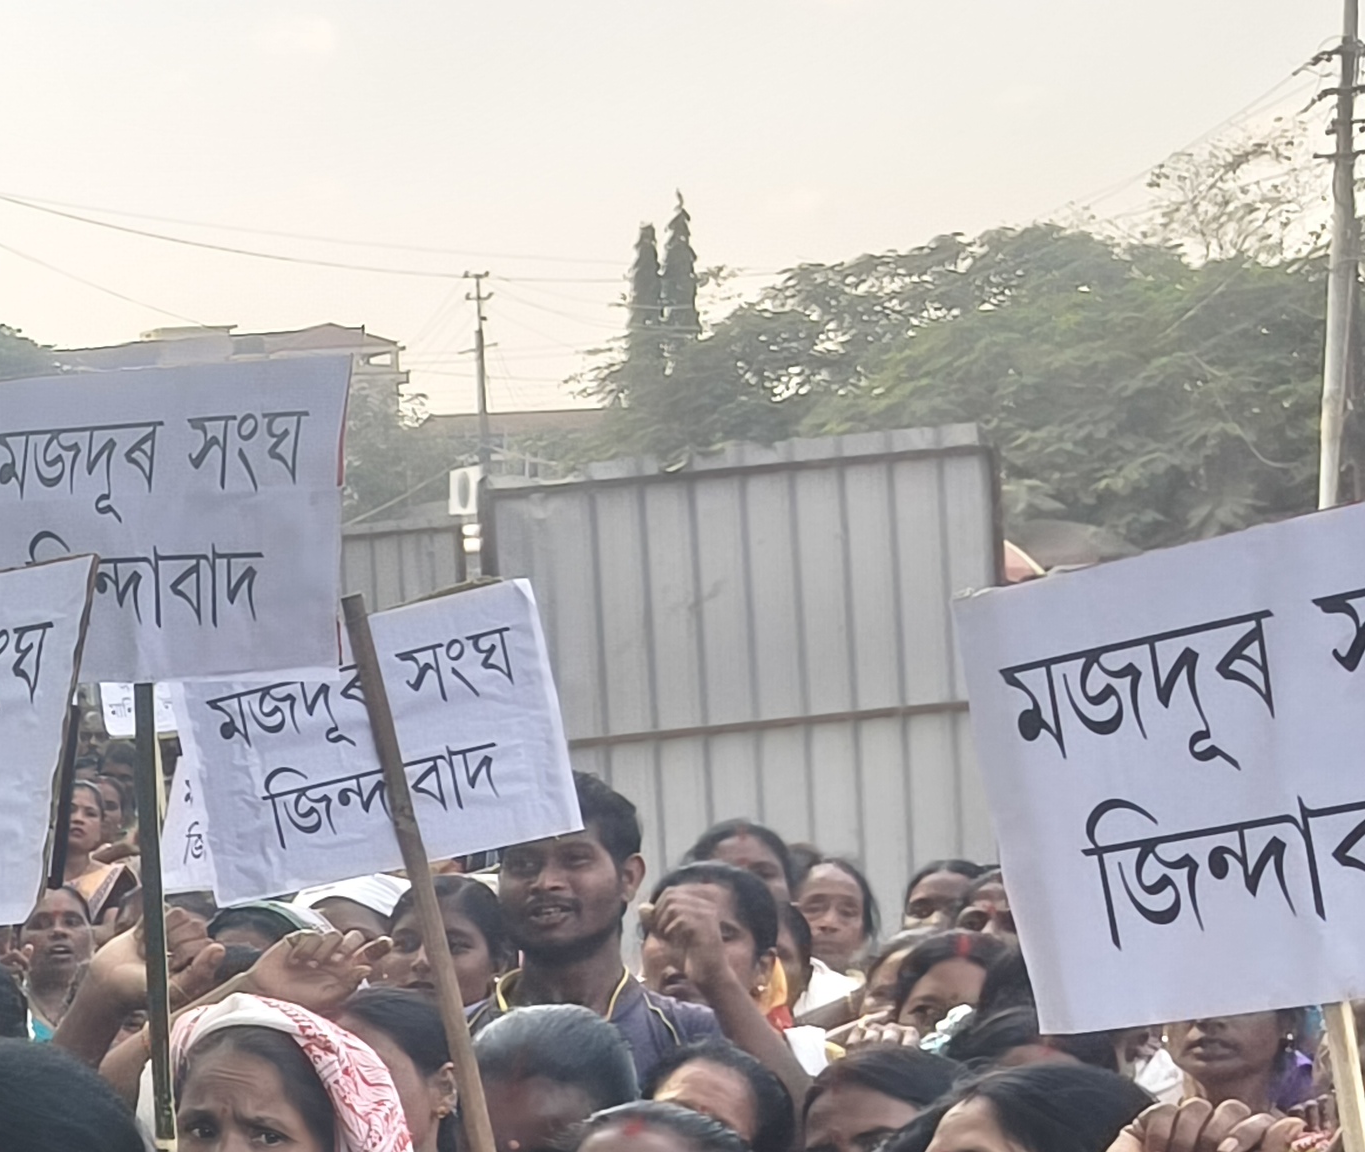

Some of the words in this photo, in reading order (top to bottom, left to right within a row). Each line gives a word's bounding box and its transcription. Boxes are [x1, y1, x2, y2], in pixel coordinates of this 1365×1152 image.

[187, 410, 310, 493] সংঘ
[395, 626, 514, 702] সংঘ
[999, 608, 1275, 771] মজদূৰ
